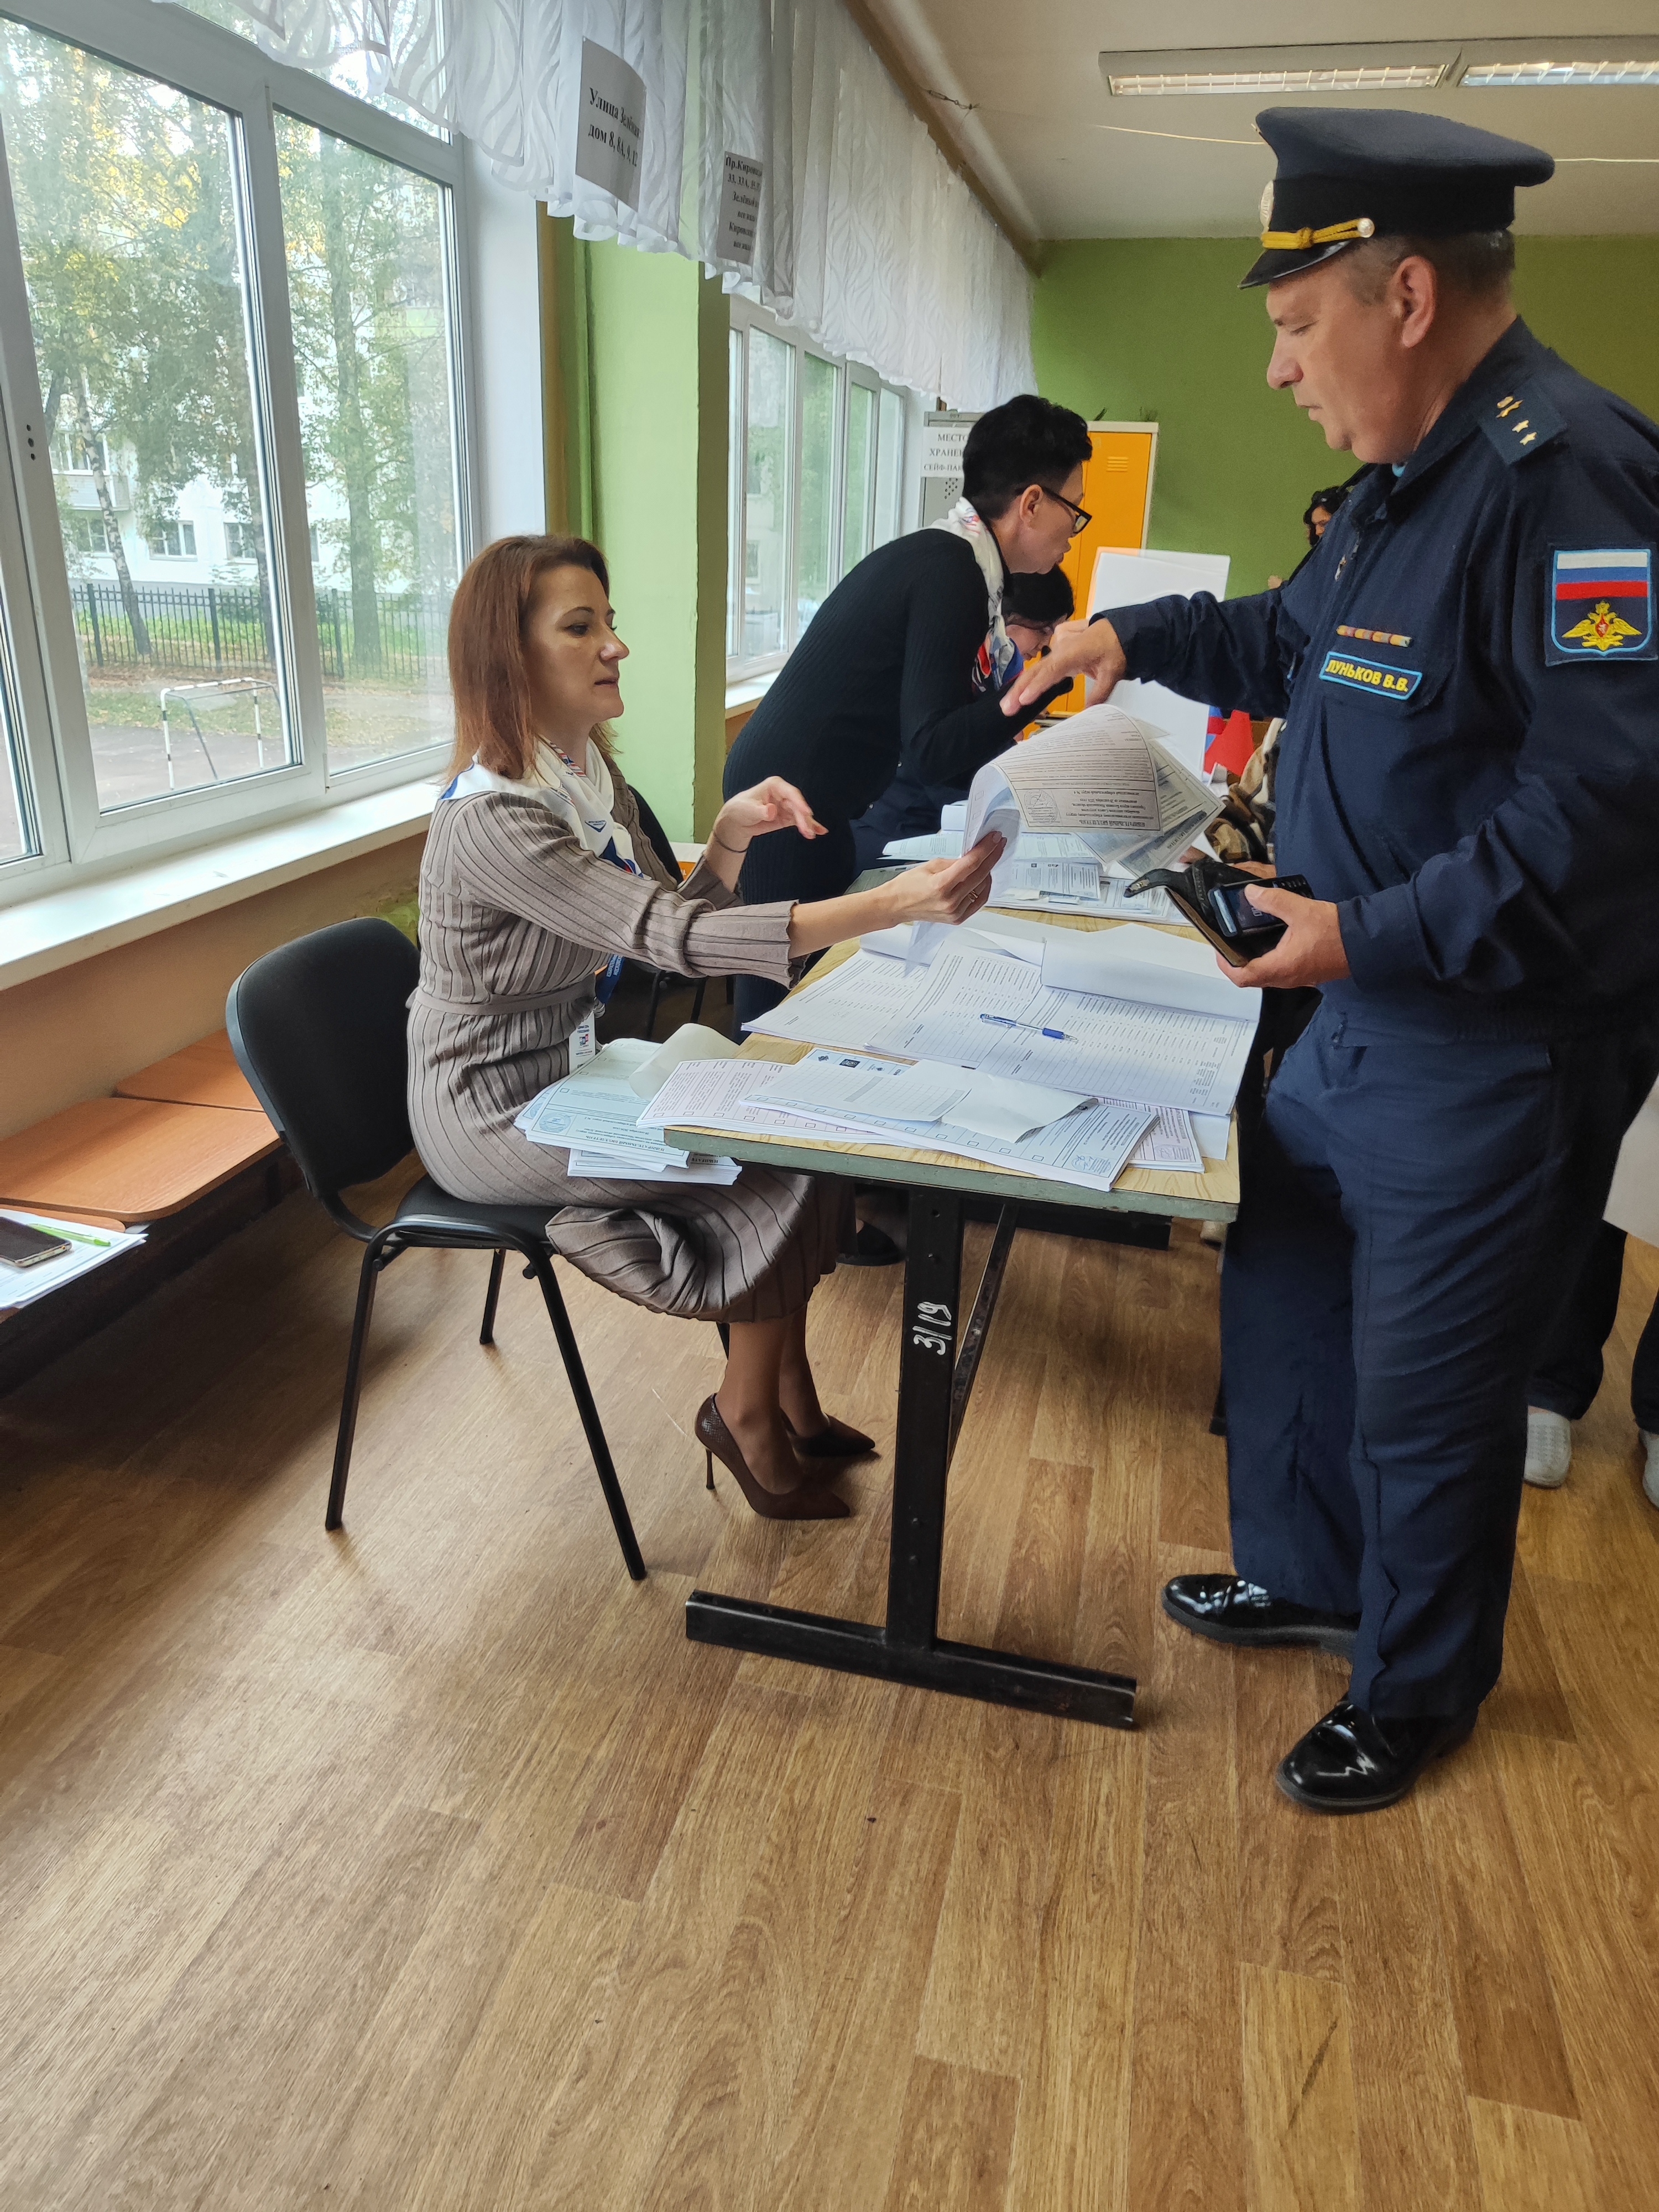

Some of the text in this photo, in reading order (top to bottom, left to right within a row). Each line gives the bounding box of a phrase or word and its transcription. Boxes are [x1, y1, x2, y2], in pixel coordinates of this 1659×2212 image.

[589, 87, 618, 119] Улица
[588, 124, 607, 143] дом
[609, 131, 615, 152] 8,
[1383, 674, 1409, 692] В.В.
